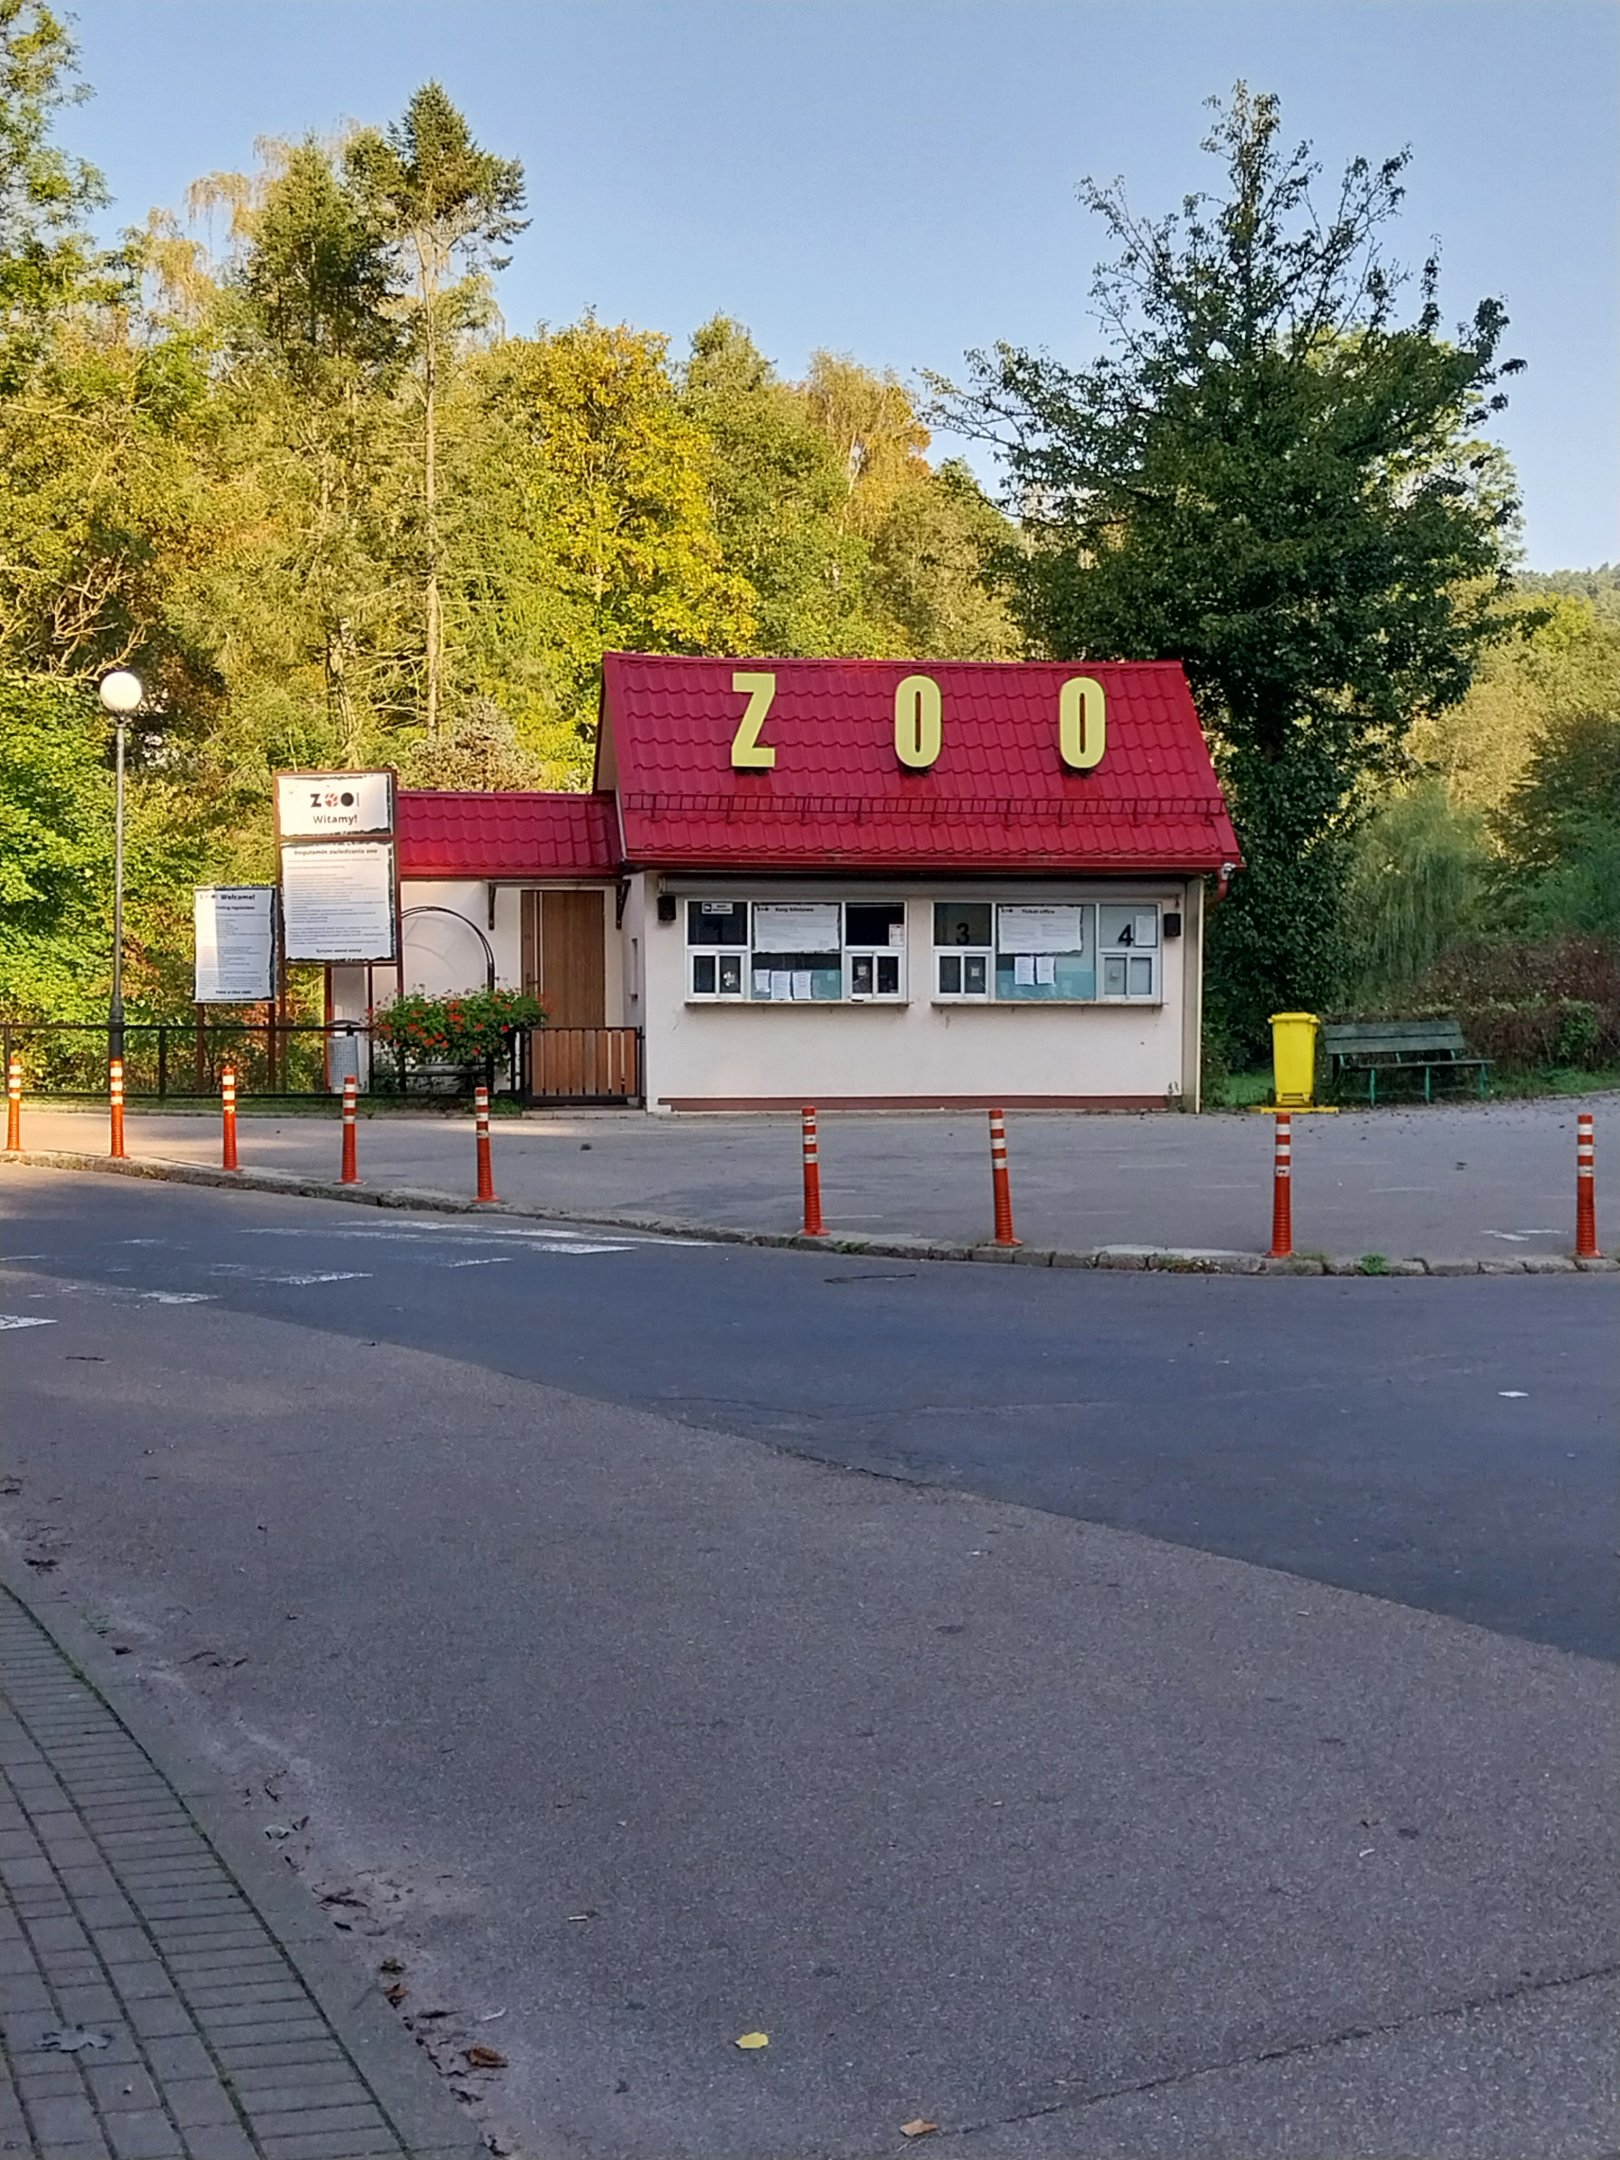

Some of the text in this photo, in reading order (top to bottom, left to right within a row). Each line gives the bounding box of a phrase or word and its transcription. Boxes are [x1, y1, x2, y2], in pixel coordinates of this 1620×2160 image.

[313, 814, 358, 826] Witamy!
[956, 922, 970, 946] 3
[1118, 924, 1135, 947] 4
